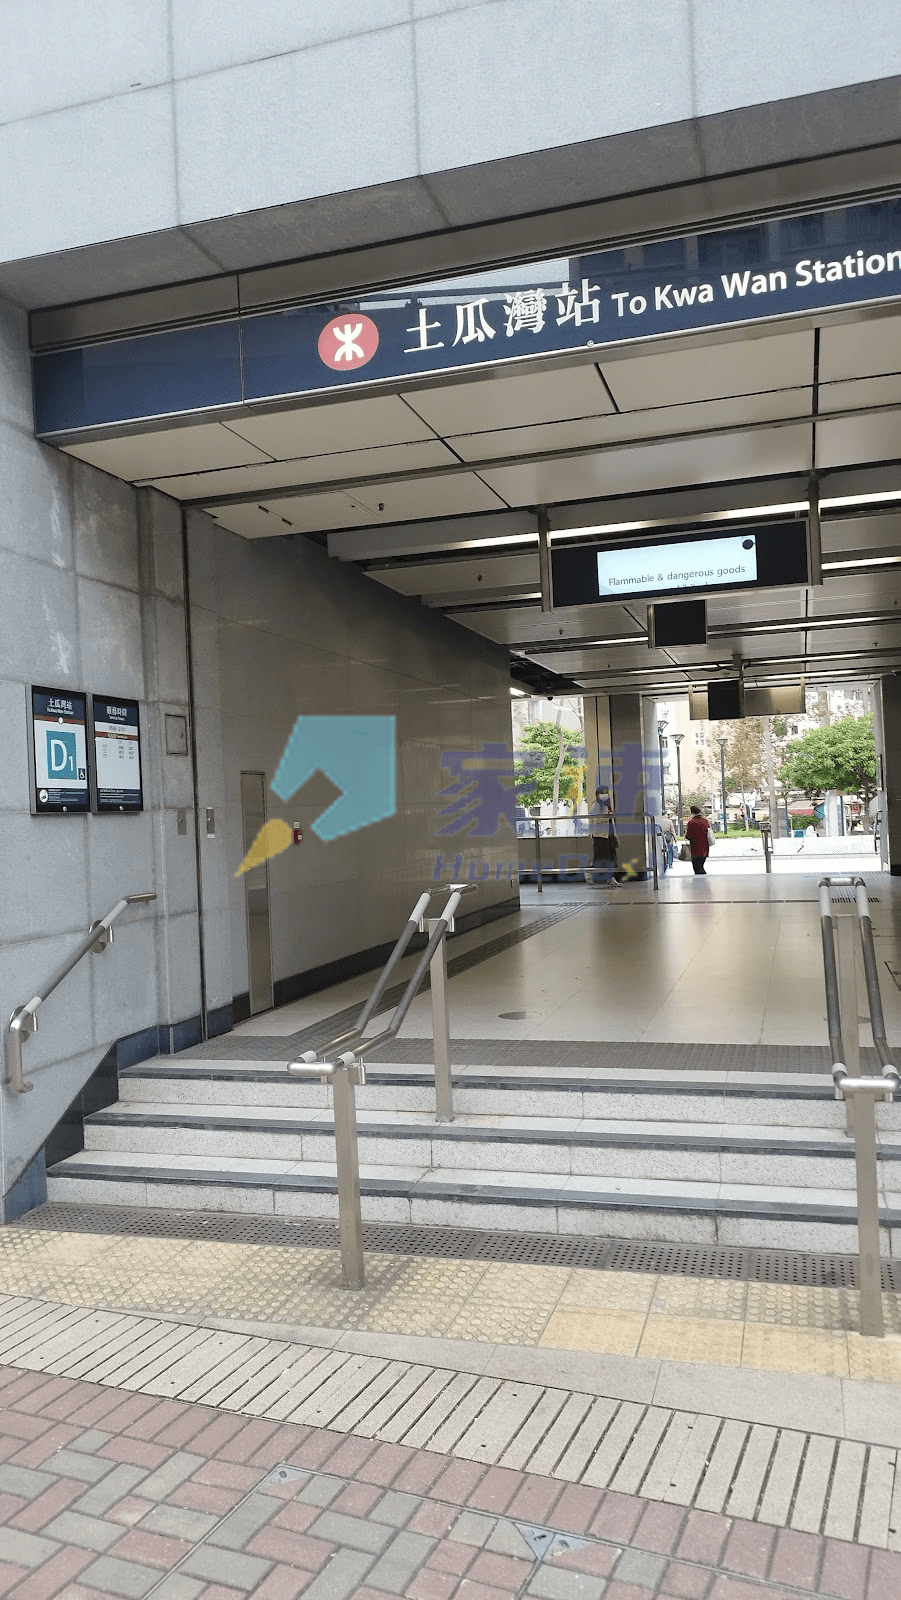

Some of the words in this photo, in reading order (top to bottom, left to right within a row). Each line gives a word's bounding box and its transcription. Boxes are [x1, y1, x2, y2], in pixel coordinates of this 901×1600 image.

[403, 279, 601, 353] 土瓜灣站
[611, 292, 647, 317] To
[654, 283, 714, 310] Kwa
[721, 270, 787, 298] Wan
[795, 250, 901, 286] Station
[608, 574, 655, 586] Flammable
[657, 573, 664, 581] &
[667, 568, 714, 581] dangerous
[717, 565, 746, 577] goods
